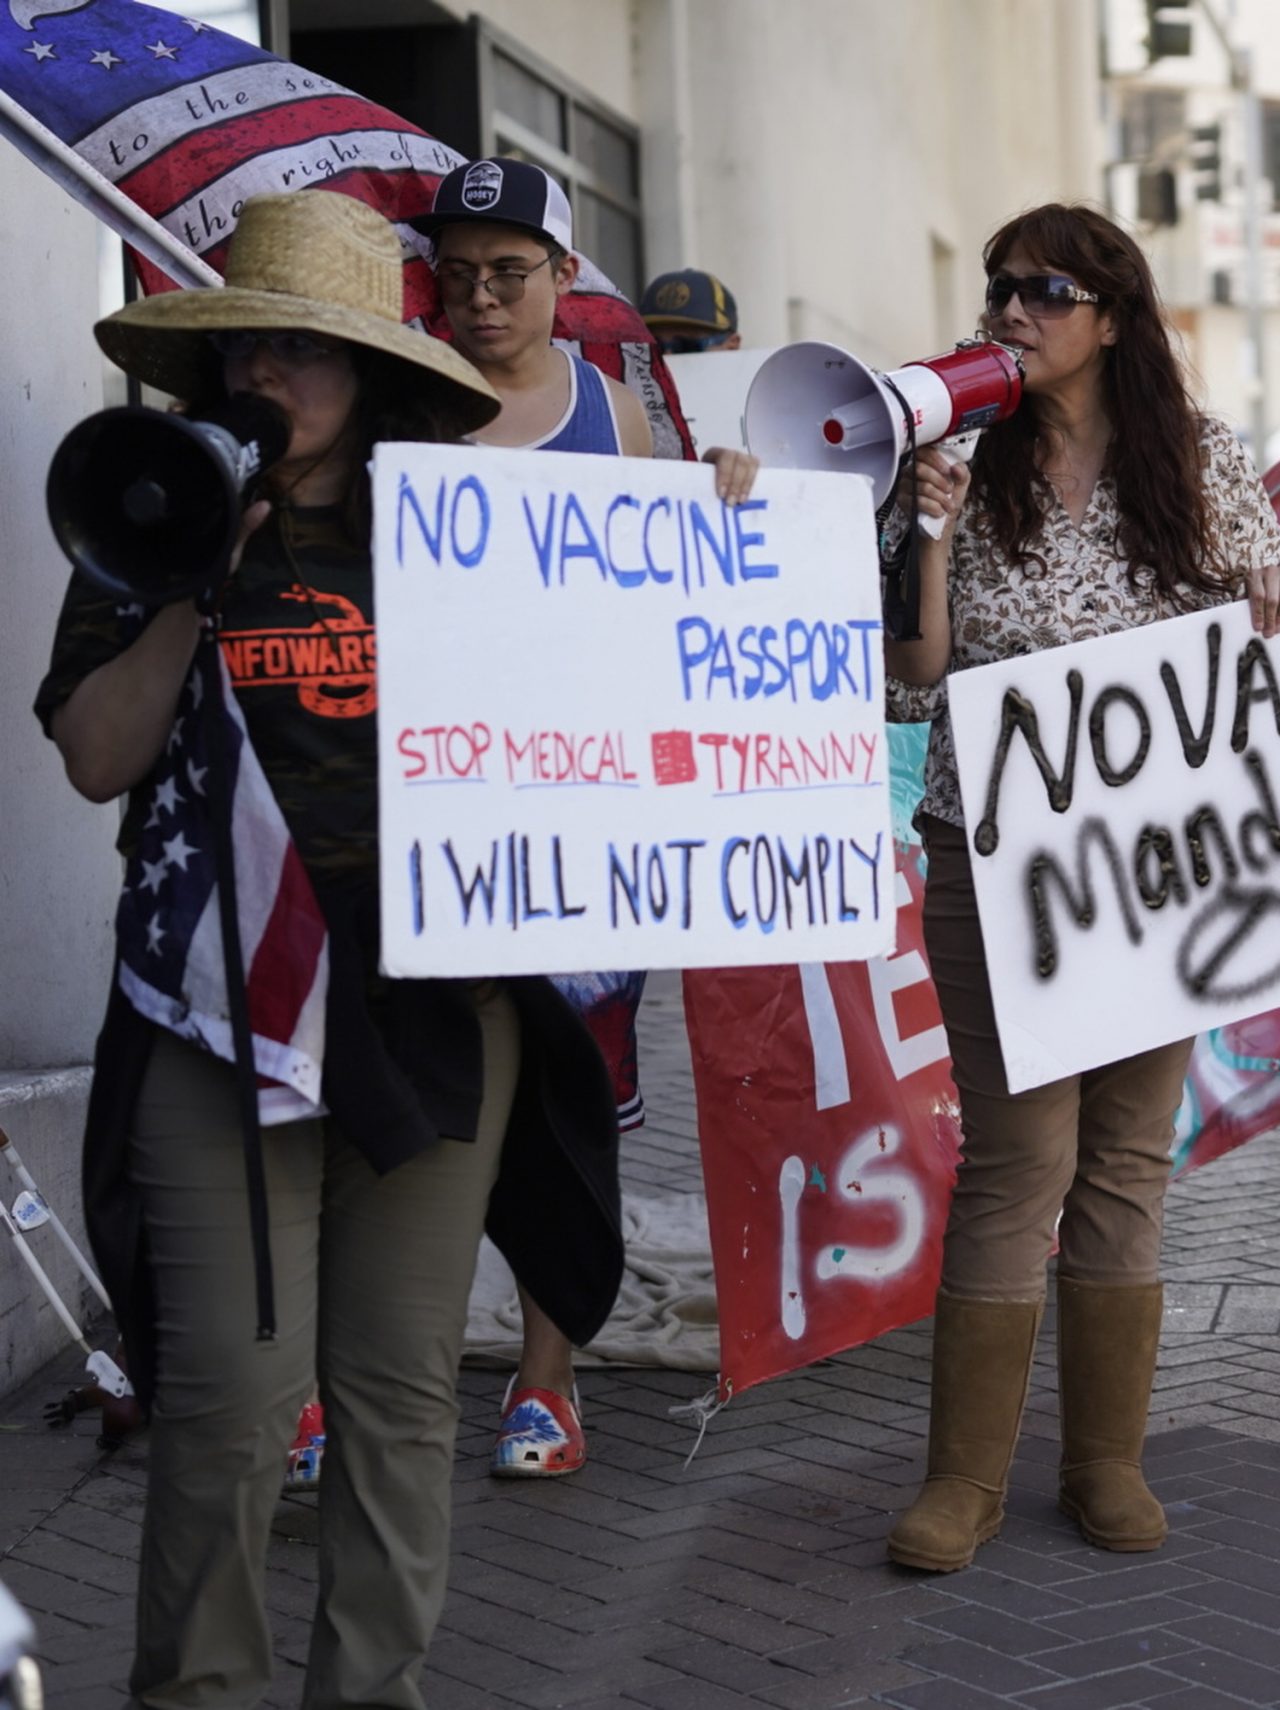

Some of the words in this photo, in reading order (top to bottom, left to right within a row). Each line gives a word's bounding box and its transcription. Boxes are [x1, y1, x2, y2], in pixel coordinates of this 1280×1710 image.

[108, 133, 150, 166] to
[186, 86, 249, 120] the
[282, 139, 360, 186] right
[390, 133, 415, 169] of
[395, 472, 491, 570] NO
[522, 491, 779, 597] VACCINE
[221, 633, 377, 679] NFOWARS
[676, 615, 884, 703] PASSPORT
[396, 721, 492, 779] STOP
[504, 728, 638, 784] MEDICAL
[698, 731, 879, 792] TYRANNY
[974, 668, 1151, 858] NO
[408, 838, 426, 936] I
[442, 830, 586, 931] WILL
[607, 838, 706, 931] NOT
[720, 831, 885, 936] COMPLY
[778, 1121, 928, 1341] IS
